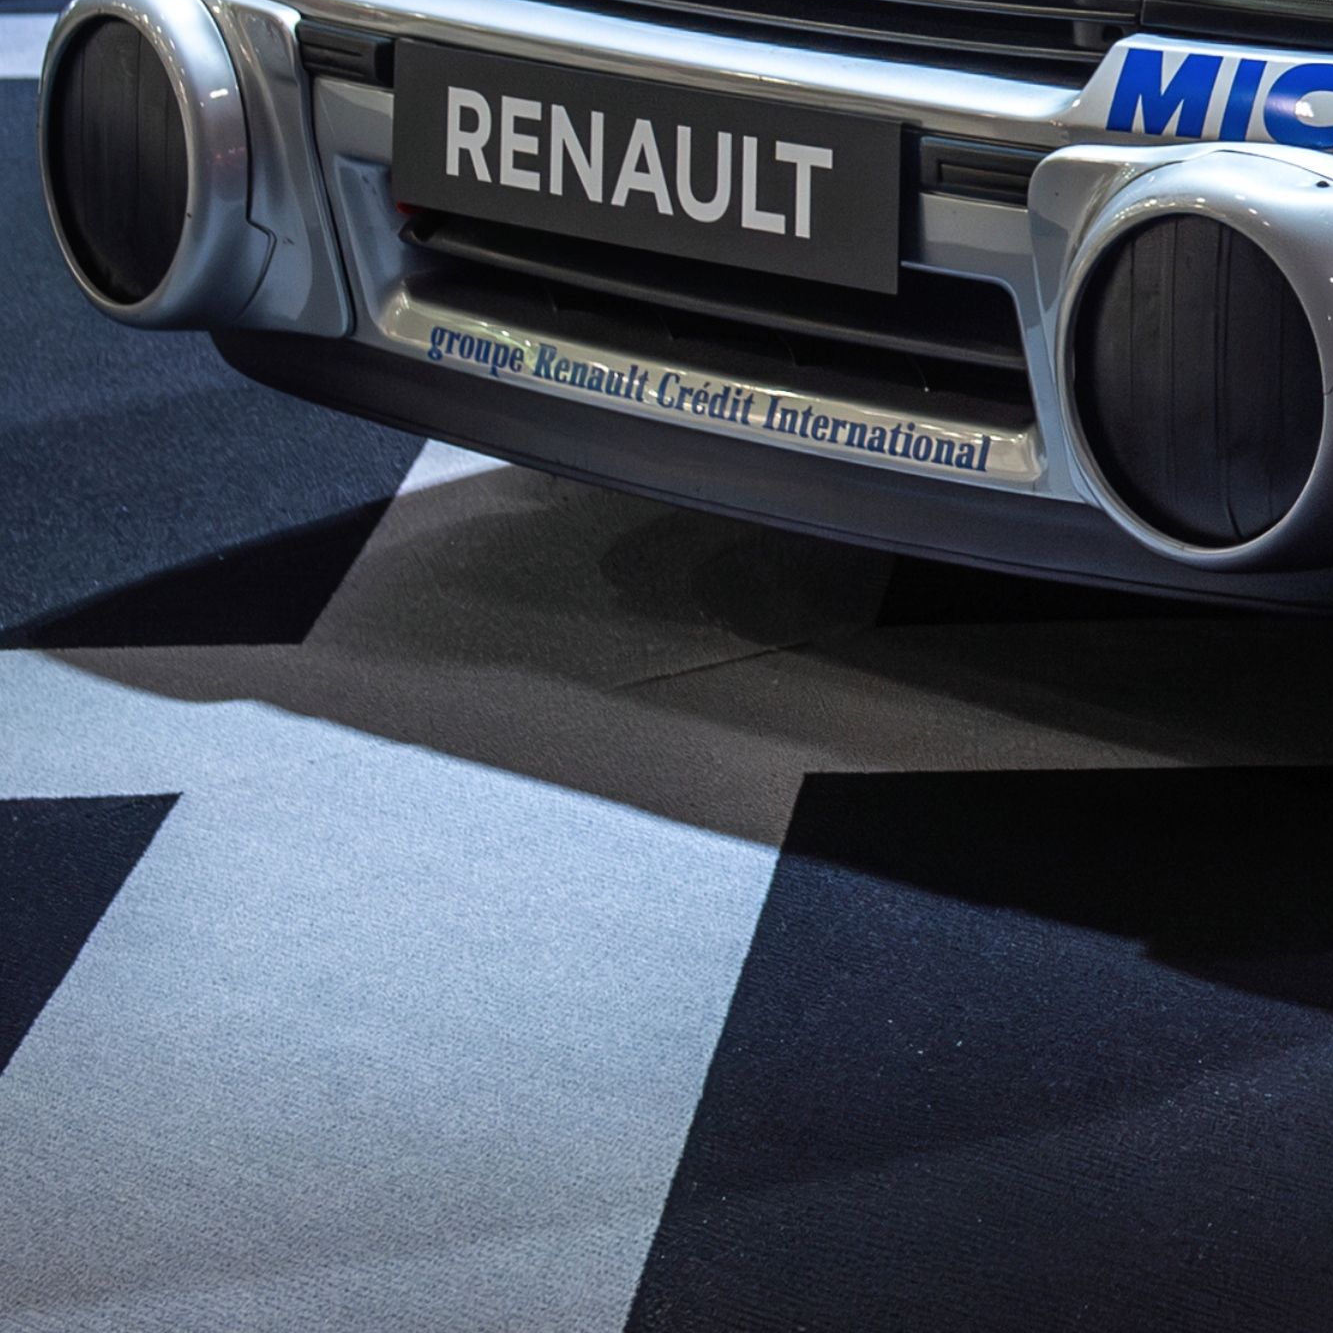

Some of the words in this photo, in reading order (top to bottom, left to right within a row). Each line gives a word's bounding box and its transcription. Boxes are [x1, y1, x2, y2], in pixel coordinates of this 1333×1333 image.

[446, 86, 833, 239] RENAULT
[428, 325, 525, 376] groupe
[533, 342, 650, 402] Renault
[656, 370, 756, 425] Crédit
[761, 395, 992, 473] International
